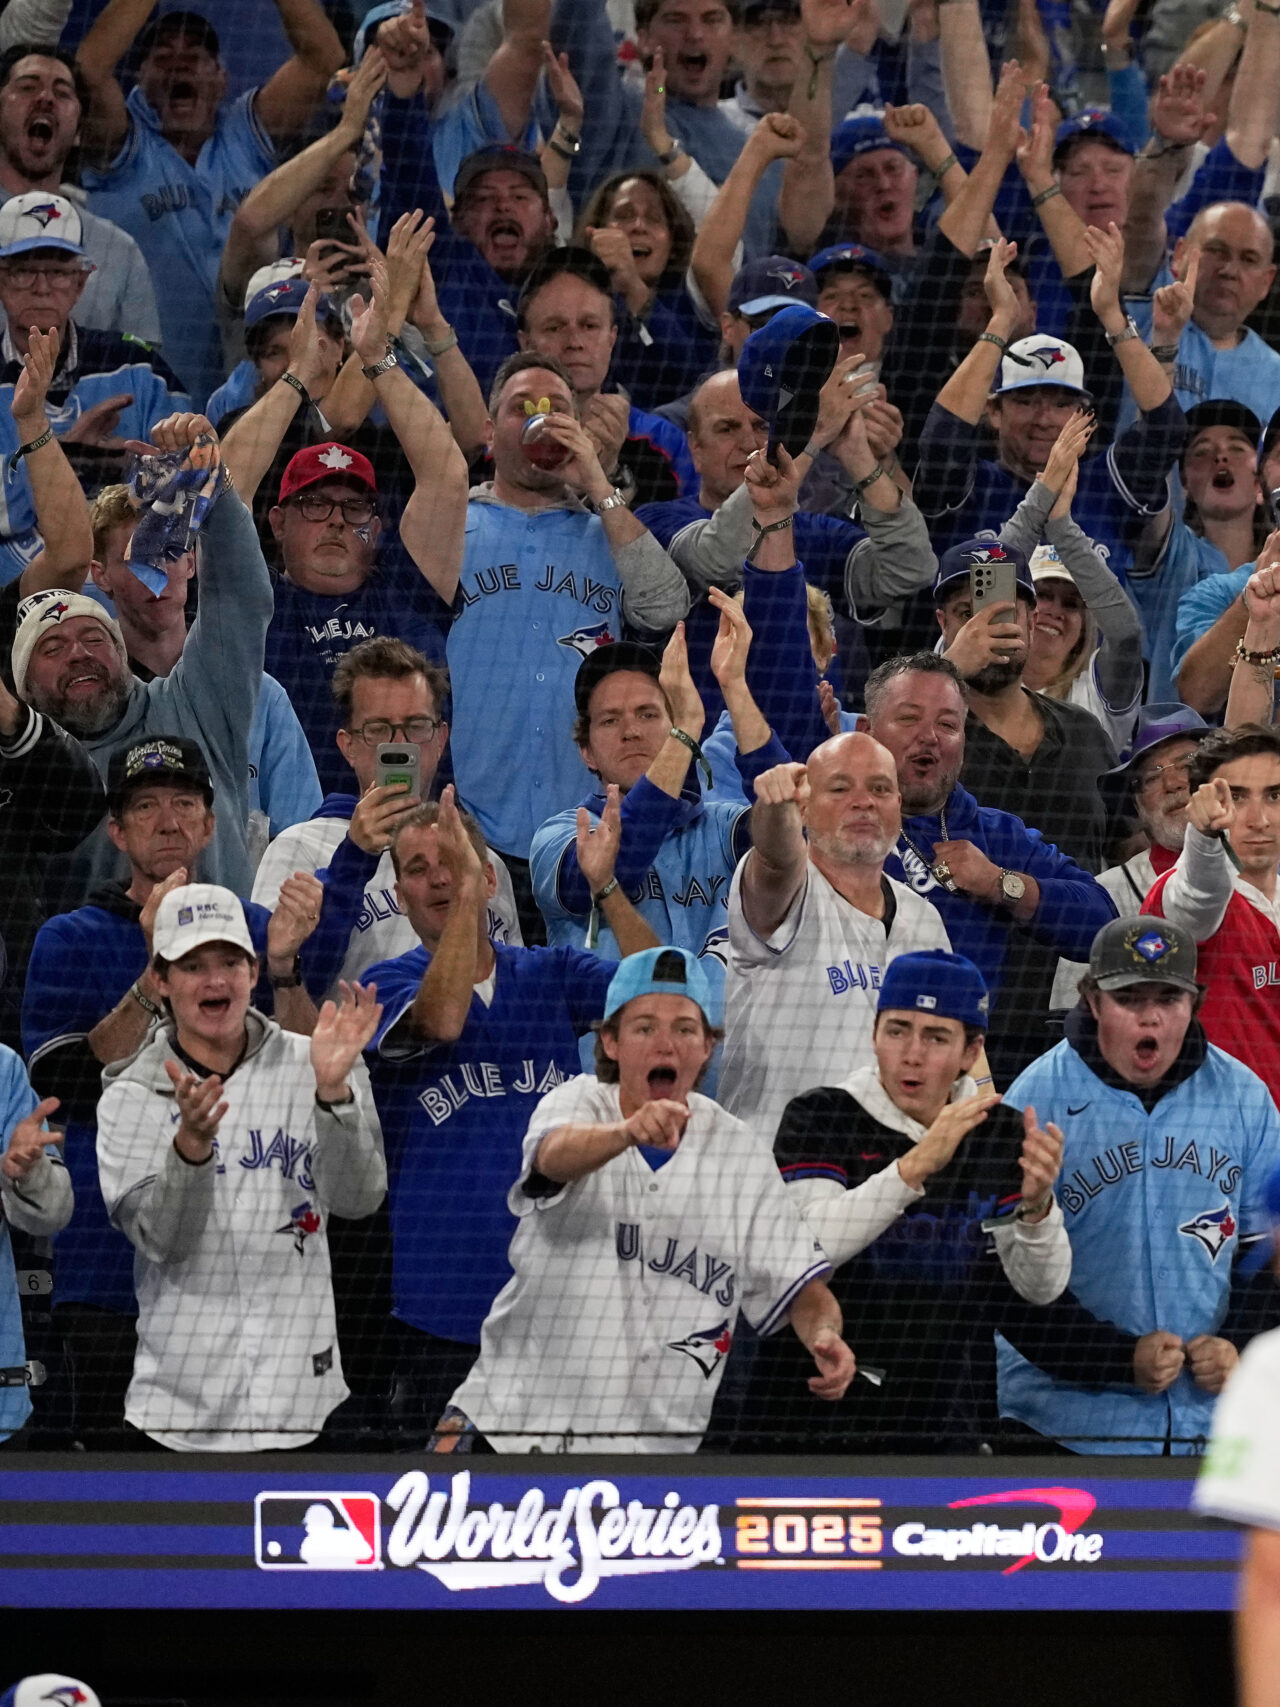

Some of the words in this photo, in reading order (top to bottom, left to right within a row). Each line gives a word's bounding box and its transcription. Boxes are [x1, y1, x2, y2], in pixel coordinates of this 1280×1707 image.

[288, 376, 303, 391] CLUB
[461, 564, 520, 608] LUE
[535, 566, 617, 613] JAYS
[417, 1061, 506, 1125] BLUE
[1061, 1141, 1143, 1215] BLUE
[1151, 1137, 1243, 1195] JAYS
[28, 1274, 39, 1291] 6
[648, 1237, 735, 1306] JAYS
[389, 1470, 580, 1567] World
[544, 1479, 723, 1602] Series
[736, 1515, 883, 1553] 2025
